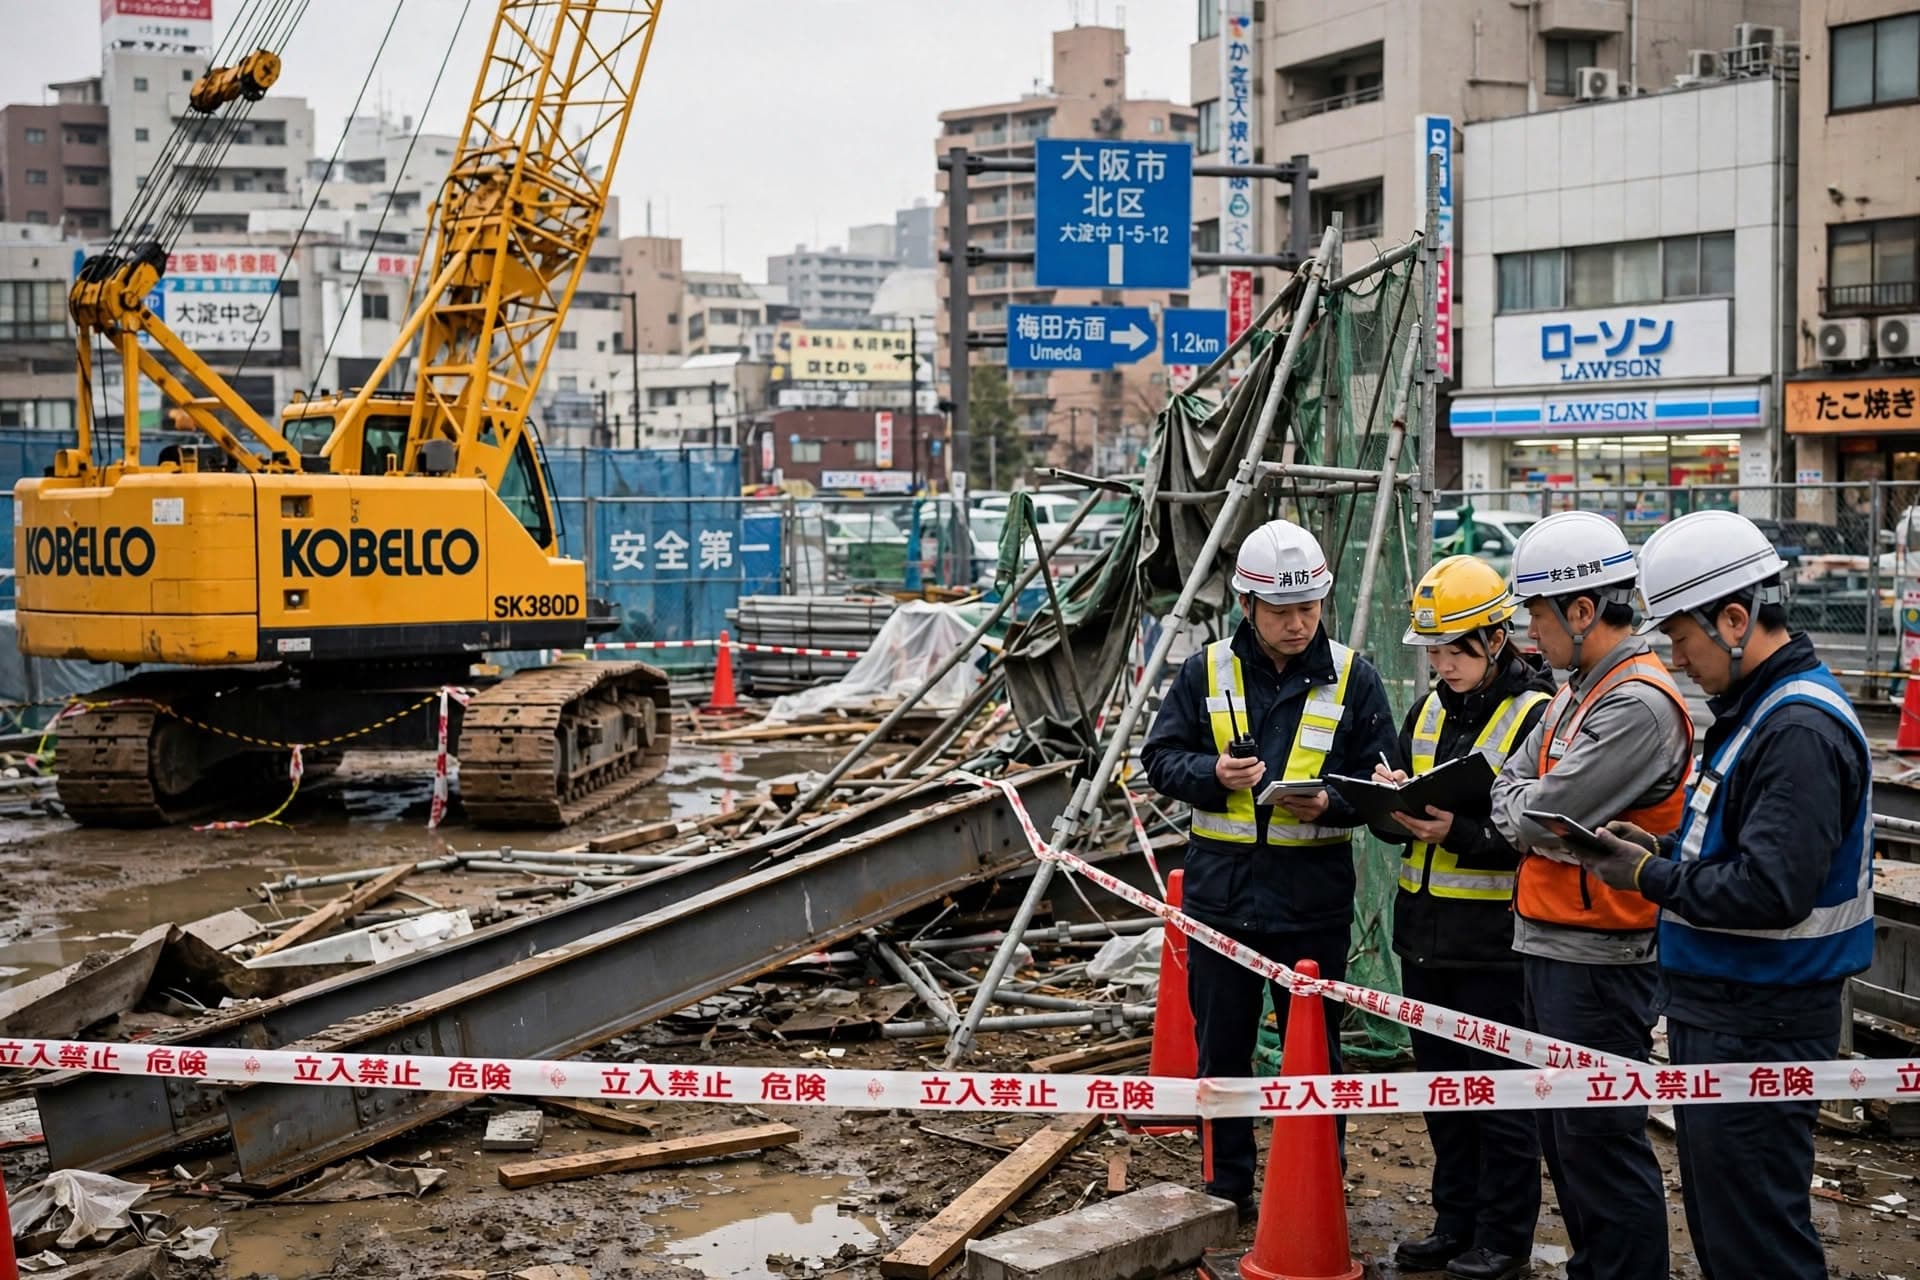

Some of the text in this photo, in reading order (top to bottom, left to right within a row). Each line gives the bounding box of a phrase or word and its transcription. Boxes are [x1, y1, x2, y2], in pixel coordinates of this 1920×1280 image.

[1062, 147, 1167, 182] 大阪市
[1083, 186, 1145, 218] 北区
[1060, 223, 1169, 245] 大淀中 1-5-12
[1017, 313, 1106, 341] 梅田方面
[1171, 332, 1219, 353] 1.2km
[1540, 317, 1675, 361] ローソン
[1030, 344, 1082, 362] Umeda
[1560, 357, 1662, 381] LAWSON
[1547, 400, 1648, 424] LAWSON
[1816, 387, 1916, 421] たこ焼き
[25, 526, 155, 576] KOBELCO
[281, 528, 480, 578] KOBELCO
[609, 530, 771, 573] 安全第一
[1278, 569, 1310, 588] 消防
[494, 594, 579, 618] SK380D
[1397, 1001, 1425, 1027] 危険
[1453, 1016, 1512, 1054] 立入禁止
[0, 1041, 120, 1071] 立入禁止
[146, 1048, 208, 1076] 危険
[293, 1056, 421, 1088] 立入禁止
[448, 1062, 512, 1091] 危険
[601, 1067, 732, 1099] 立入禁止
[761, 1072, 827, 1102] 危険
[920, 1076, 1058, 1108] 立入禁止
[1086, 1080, 1155, 1110] 危険
[1259, 1080, 1398, 1111] 立入禁止
[1428, 1075, 1496, 1107] 危険
[1587, 1070, 1721, 1102] 立入禁止
[1748, 1066, 1814, 1097] 危険
